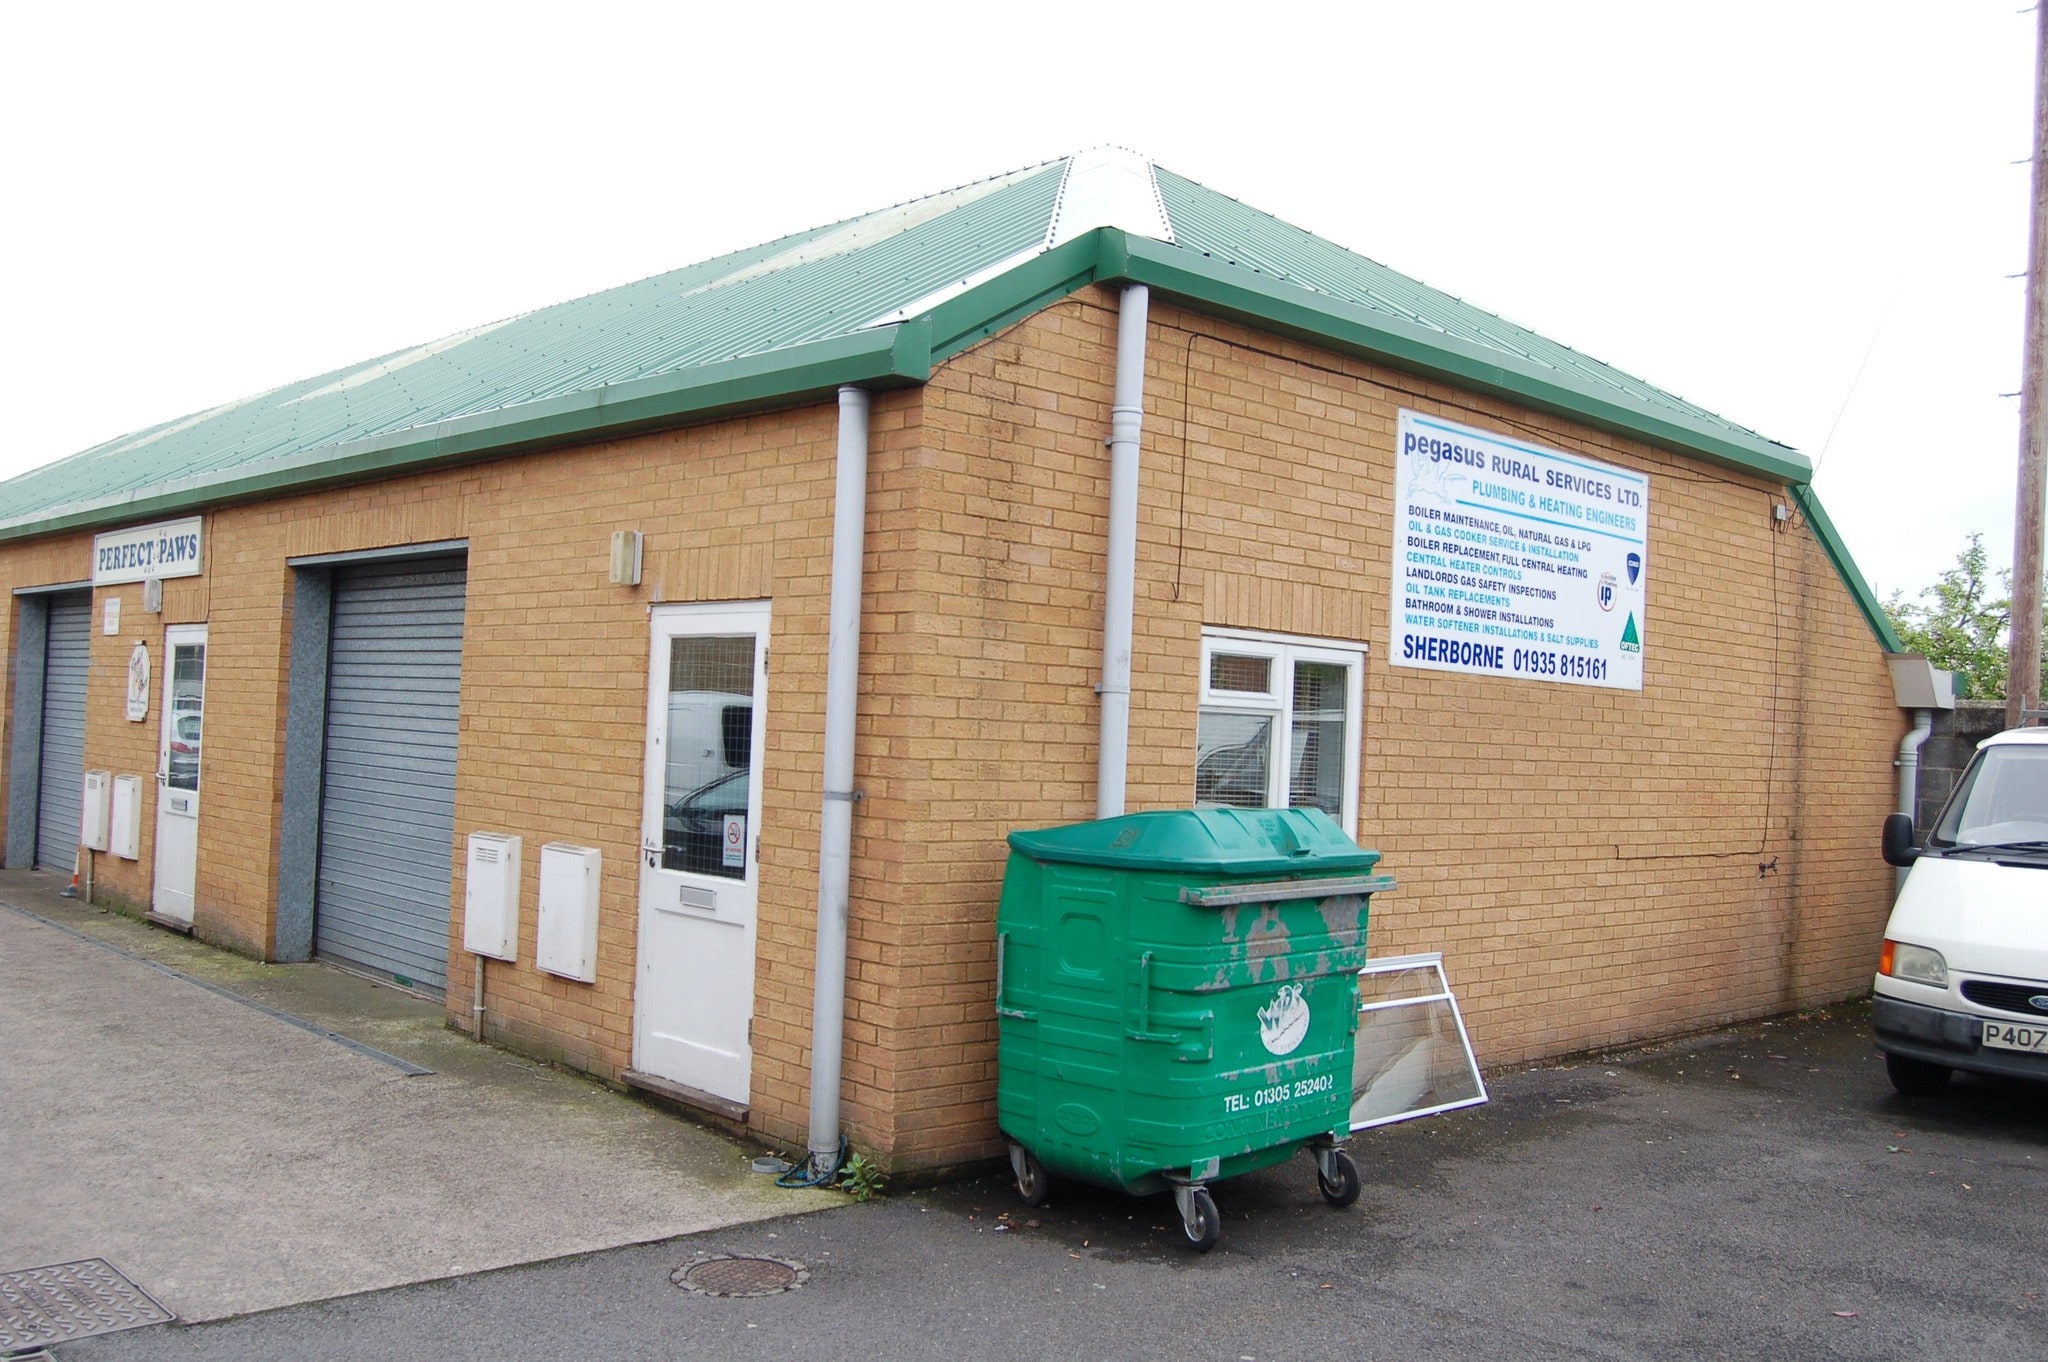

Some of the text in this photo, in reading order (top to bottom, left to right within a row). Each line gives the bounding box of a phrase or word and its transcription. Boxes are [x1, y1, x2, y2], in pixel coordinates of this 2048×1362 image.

[1404, 432, 1643, 508] pegasus RURAL SERVICES LTD.
[1472, 480, 1636, 531] PLUMBING & HEATING ENGINEERS
[1408, 505, 1441, 520] BOILER
[1443, 512, 1501, 535] MAINTENANCE,
[1519, 528, 1552, 544] NATURAL
[1554, 536, 1569, 547] GAS
[1570, 539, 1576, 548] &
[1578, 541, 1591, 552] LPG
[1408, 520, 1579, 562] OIL & GAS COOKER SERVICE & INSTALLATION
[99, 534, 197, 572] PERFECT PAWS
[1406, 551, 1522, 580] CENTRAL HEATER CONTROLS
[1407, 536, 1440, 551] BOILER
[1442, 542, 1501, 564] REPLACEMENT,
[1502, 554, 1520, 567] FULL
[1522, 558, 1555, 573] CENTRAL
[1557, 564, 1588, 579] HEATING
[1406, 567, 1557, 601] LANDLORDS GAS SAFETY INSPECTIONS
[1406, 583, 1510, 607] OIL TANK REPLACEMENTS
[1405, 598, 1554, 628] BATHROOM & SHOWER INSTALLATIONS
[1405, 613, 1599, 649] WATER SOFTENER INSTALLATIONS & SALT SUPPLIES
[1403, 634, 1607, 680] SHERBORNE 01935 815161
[1986, 1024, 2048, 1048] P407
[1224, 1094, 1250, 1113] TEL:
[1254, 1084, 1290, 1106] 01305
